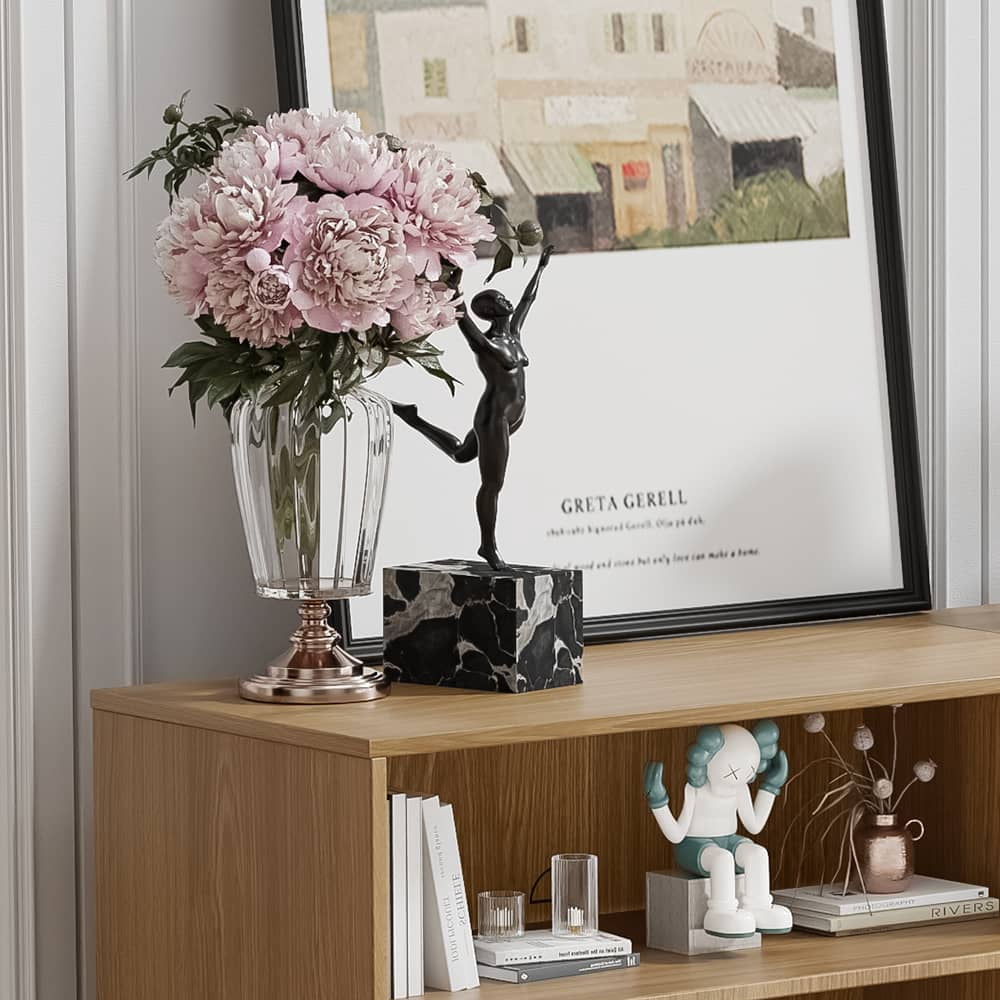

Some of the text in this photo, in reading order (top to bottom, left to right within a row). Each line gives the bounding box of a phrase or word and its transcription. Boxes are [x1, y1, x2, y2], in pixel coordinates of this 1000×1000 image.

[560, 489, 688, 515] GRETA GERELL
[931, 900, 995, 919] RIVERS
